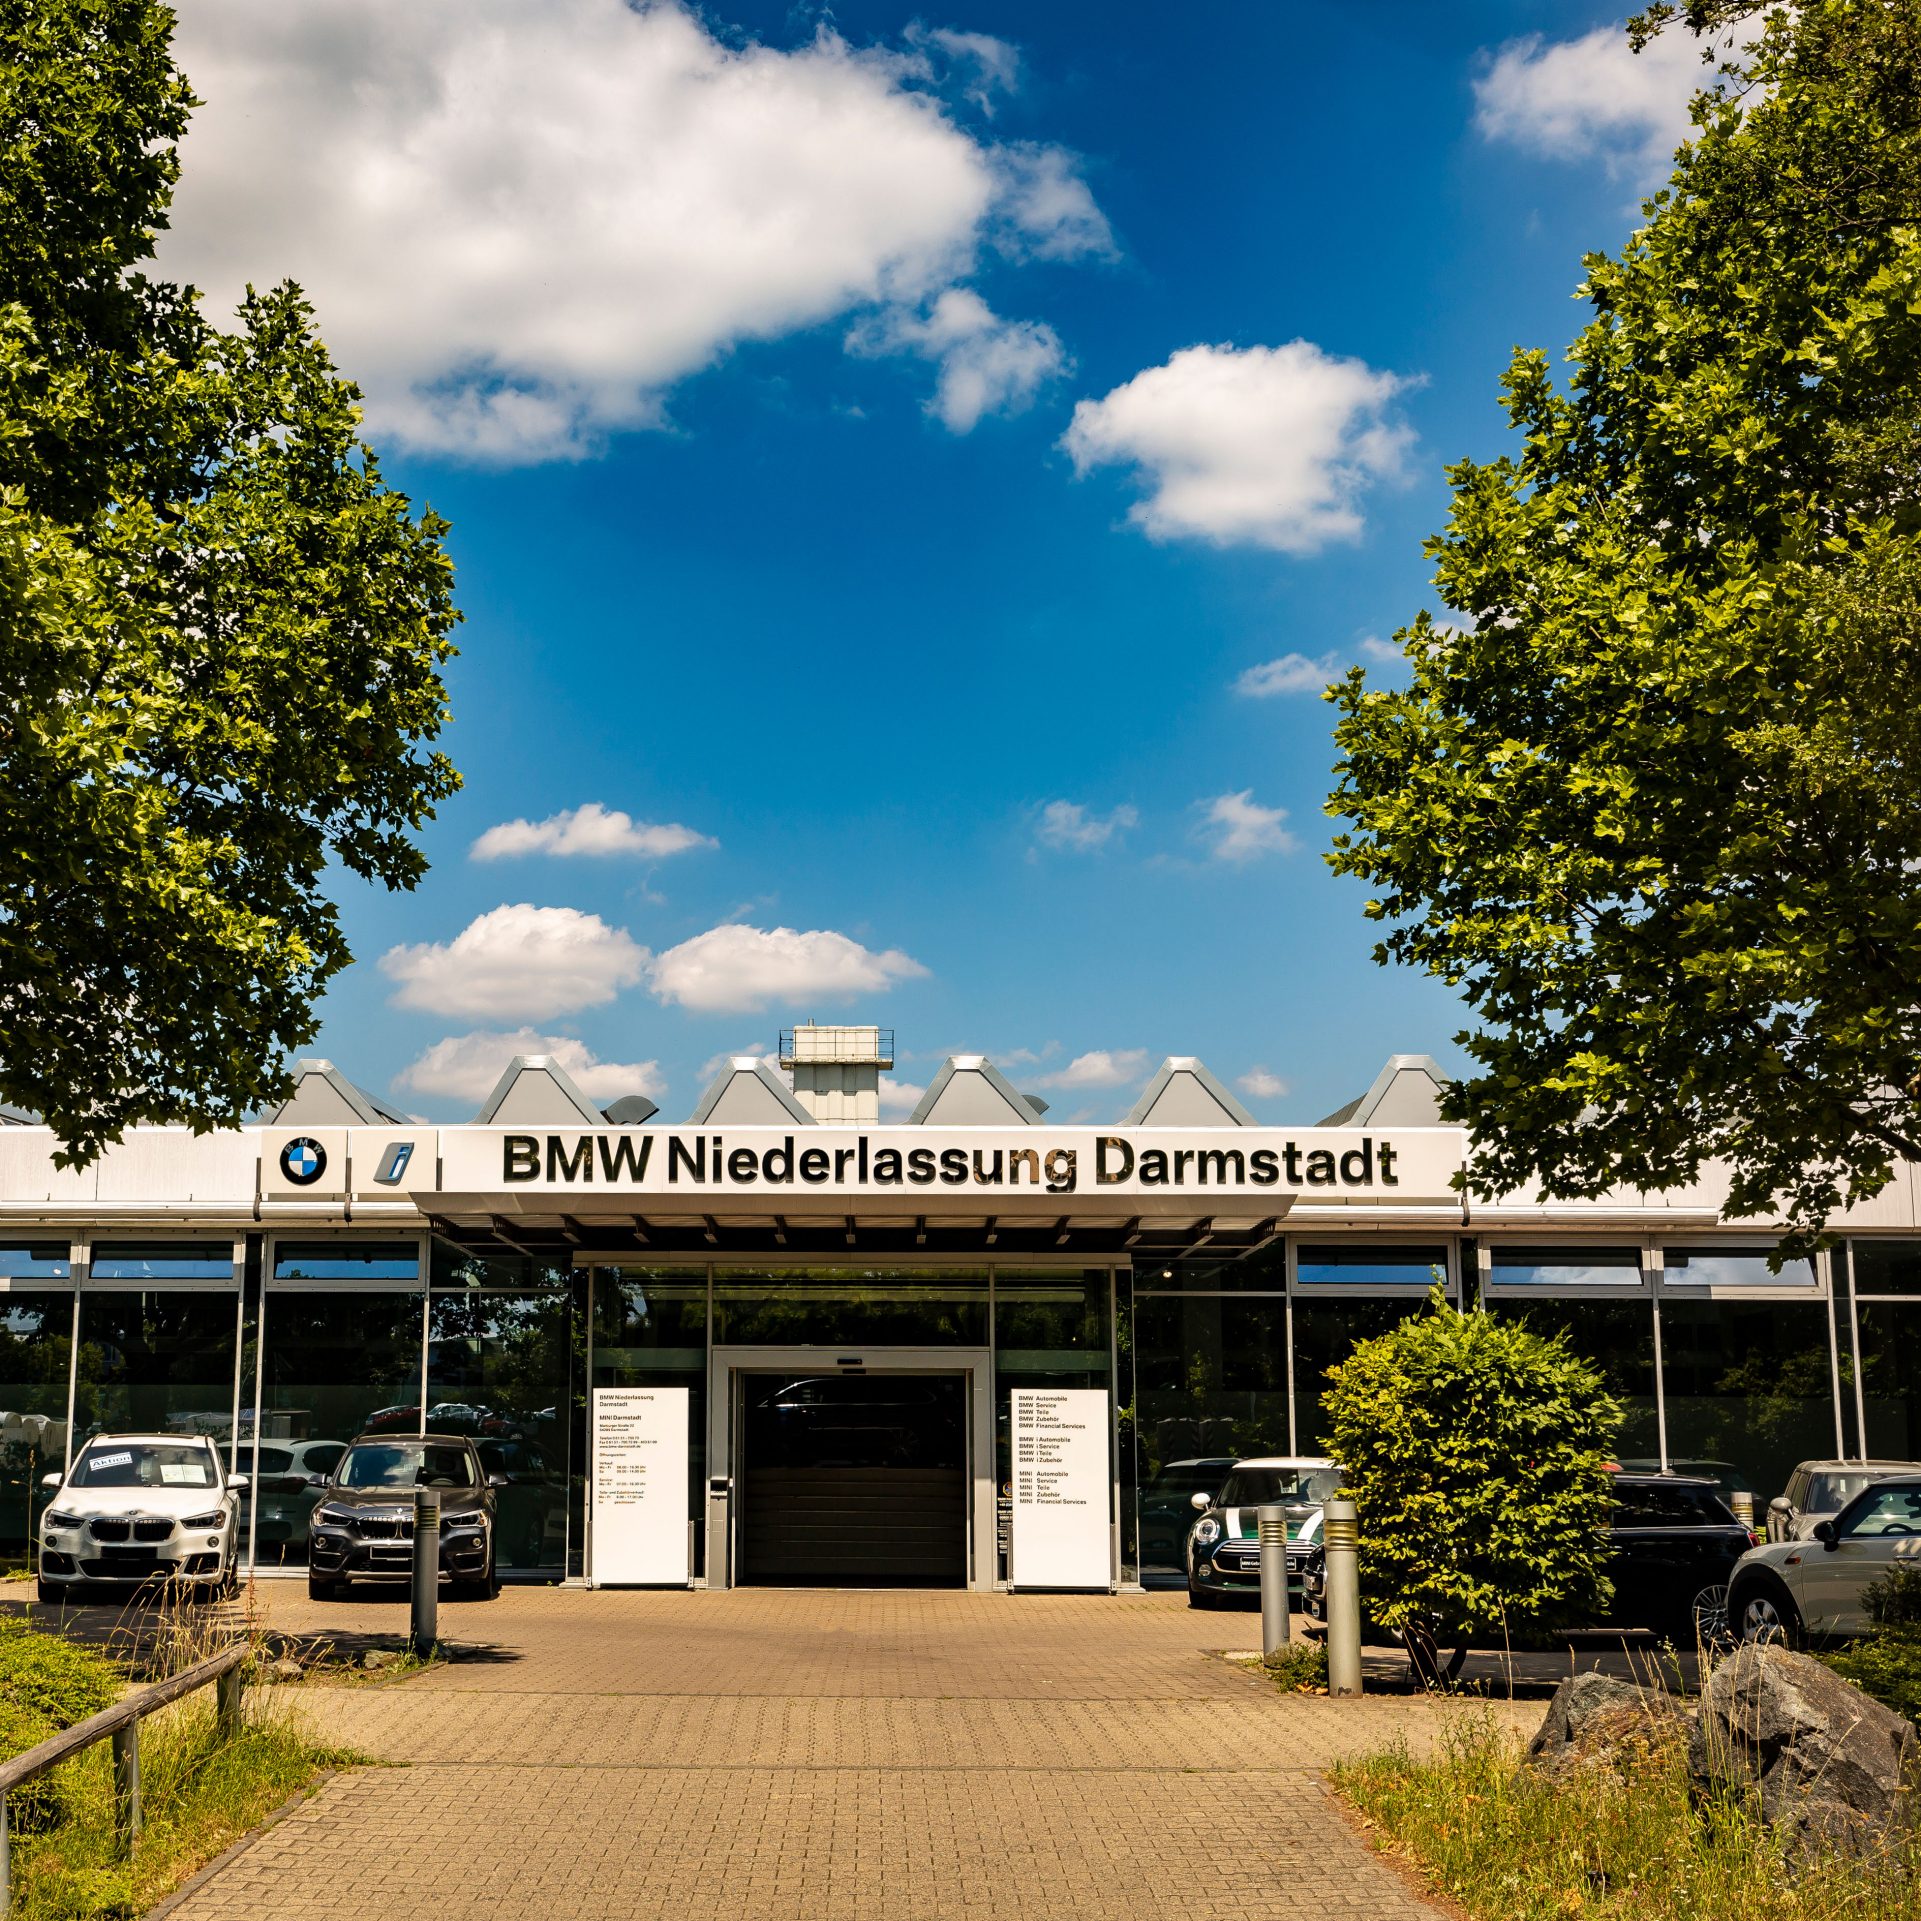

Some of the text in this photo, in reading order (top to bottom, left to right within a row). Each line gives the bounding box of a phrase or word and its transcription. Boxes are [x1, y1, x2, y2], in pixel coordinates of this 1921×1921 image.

[285, 1138, 323, 1153] BMW
[503, 1135, 1399, 1194] BMW Niederlassung Darmstadt
[92, 1455, 130, 1467] Aktion
